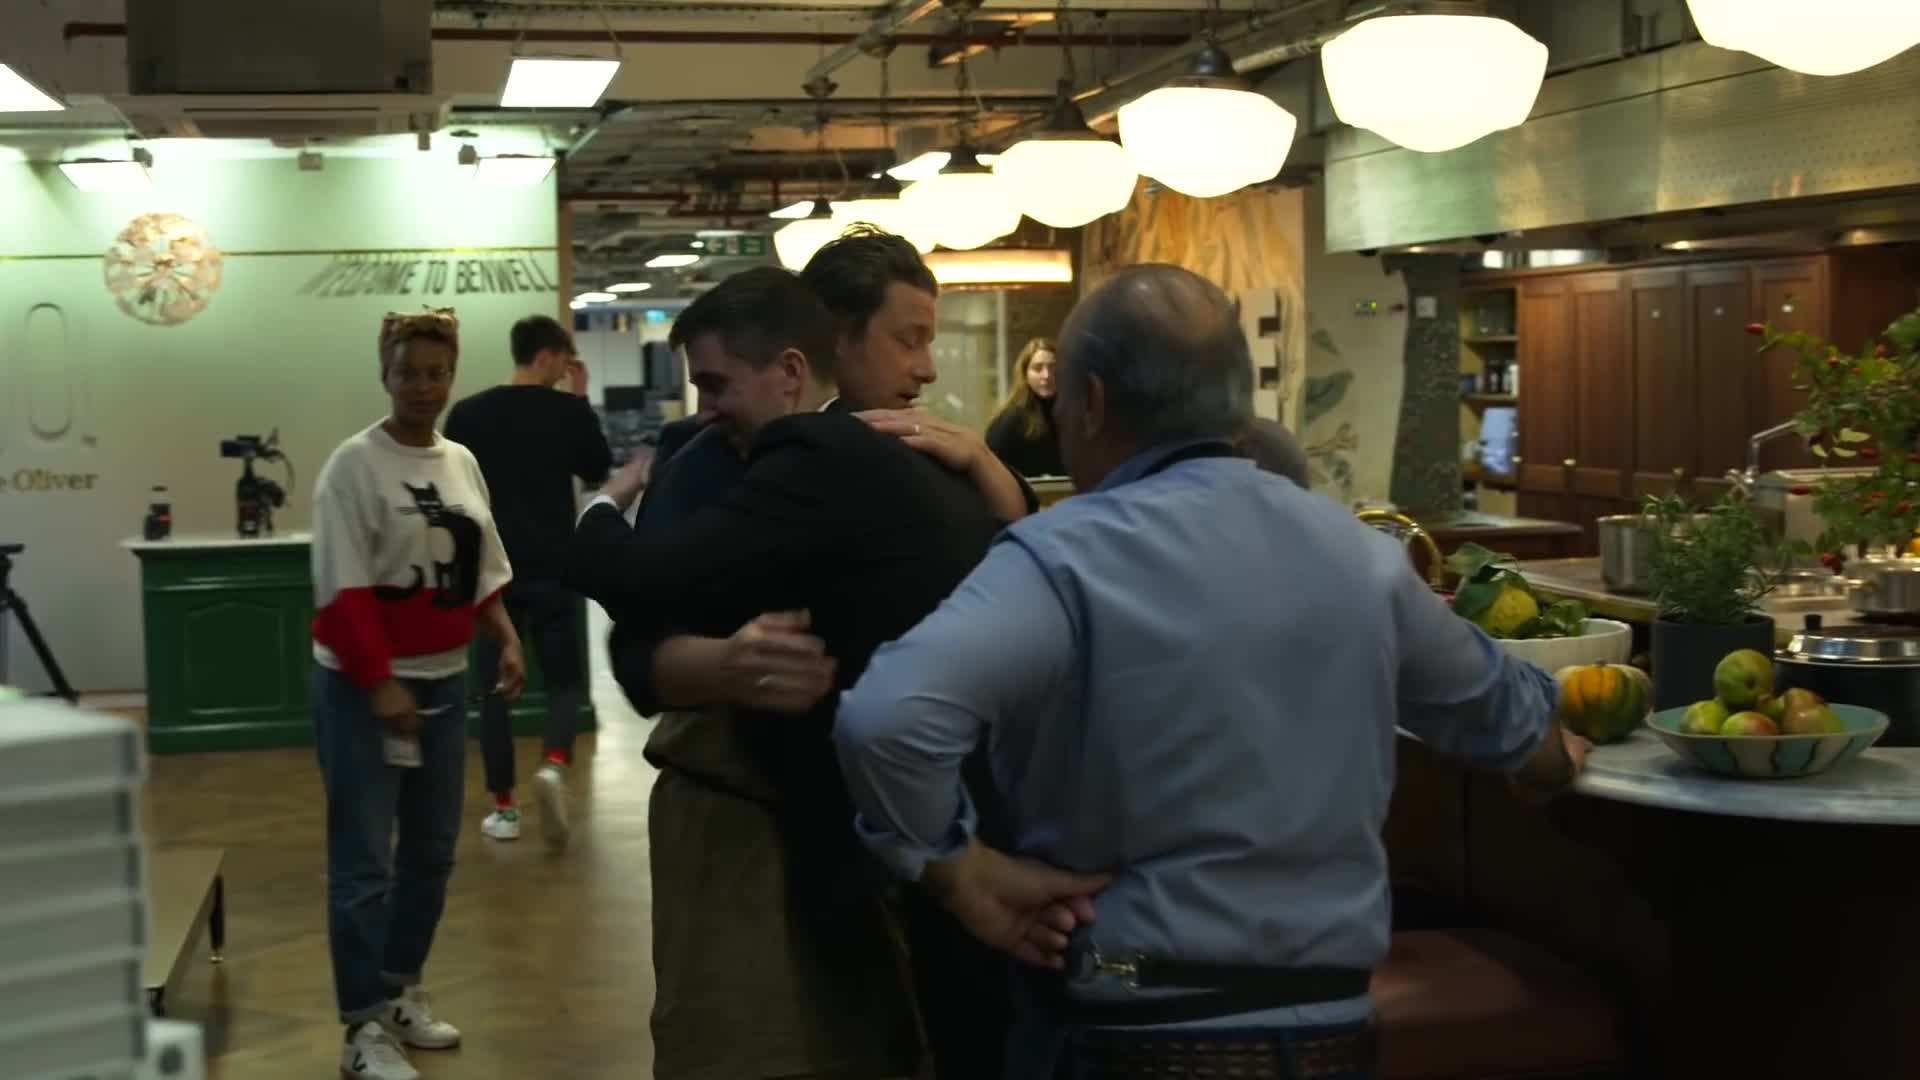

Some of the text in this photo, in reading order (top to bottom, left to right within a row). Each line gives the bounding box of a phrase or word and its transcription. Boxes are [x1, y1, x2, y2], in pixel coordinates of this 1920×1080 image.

[422, 259, 449, 295] TO
[455, 253, 559, 295] BENWELL
[14, 468, 99, 491] Oliver
